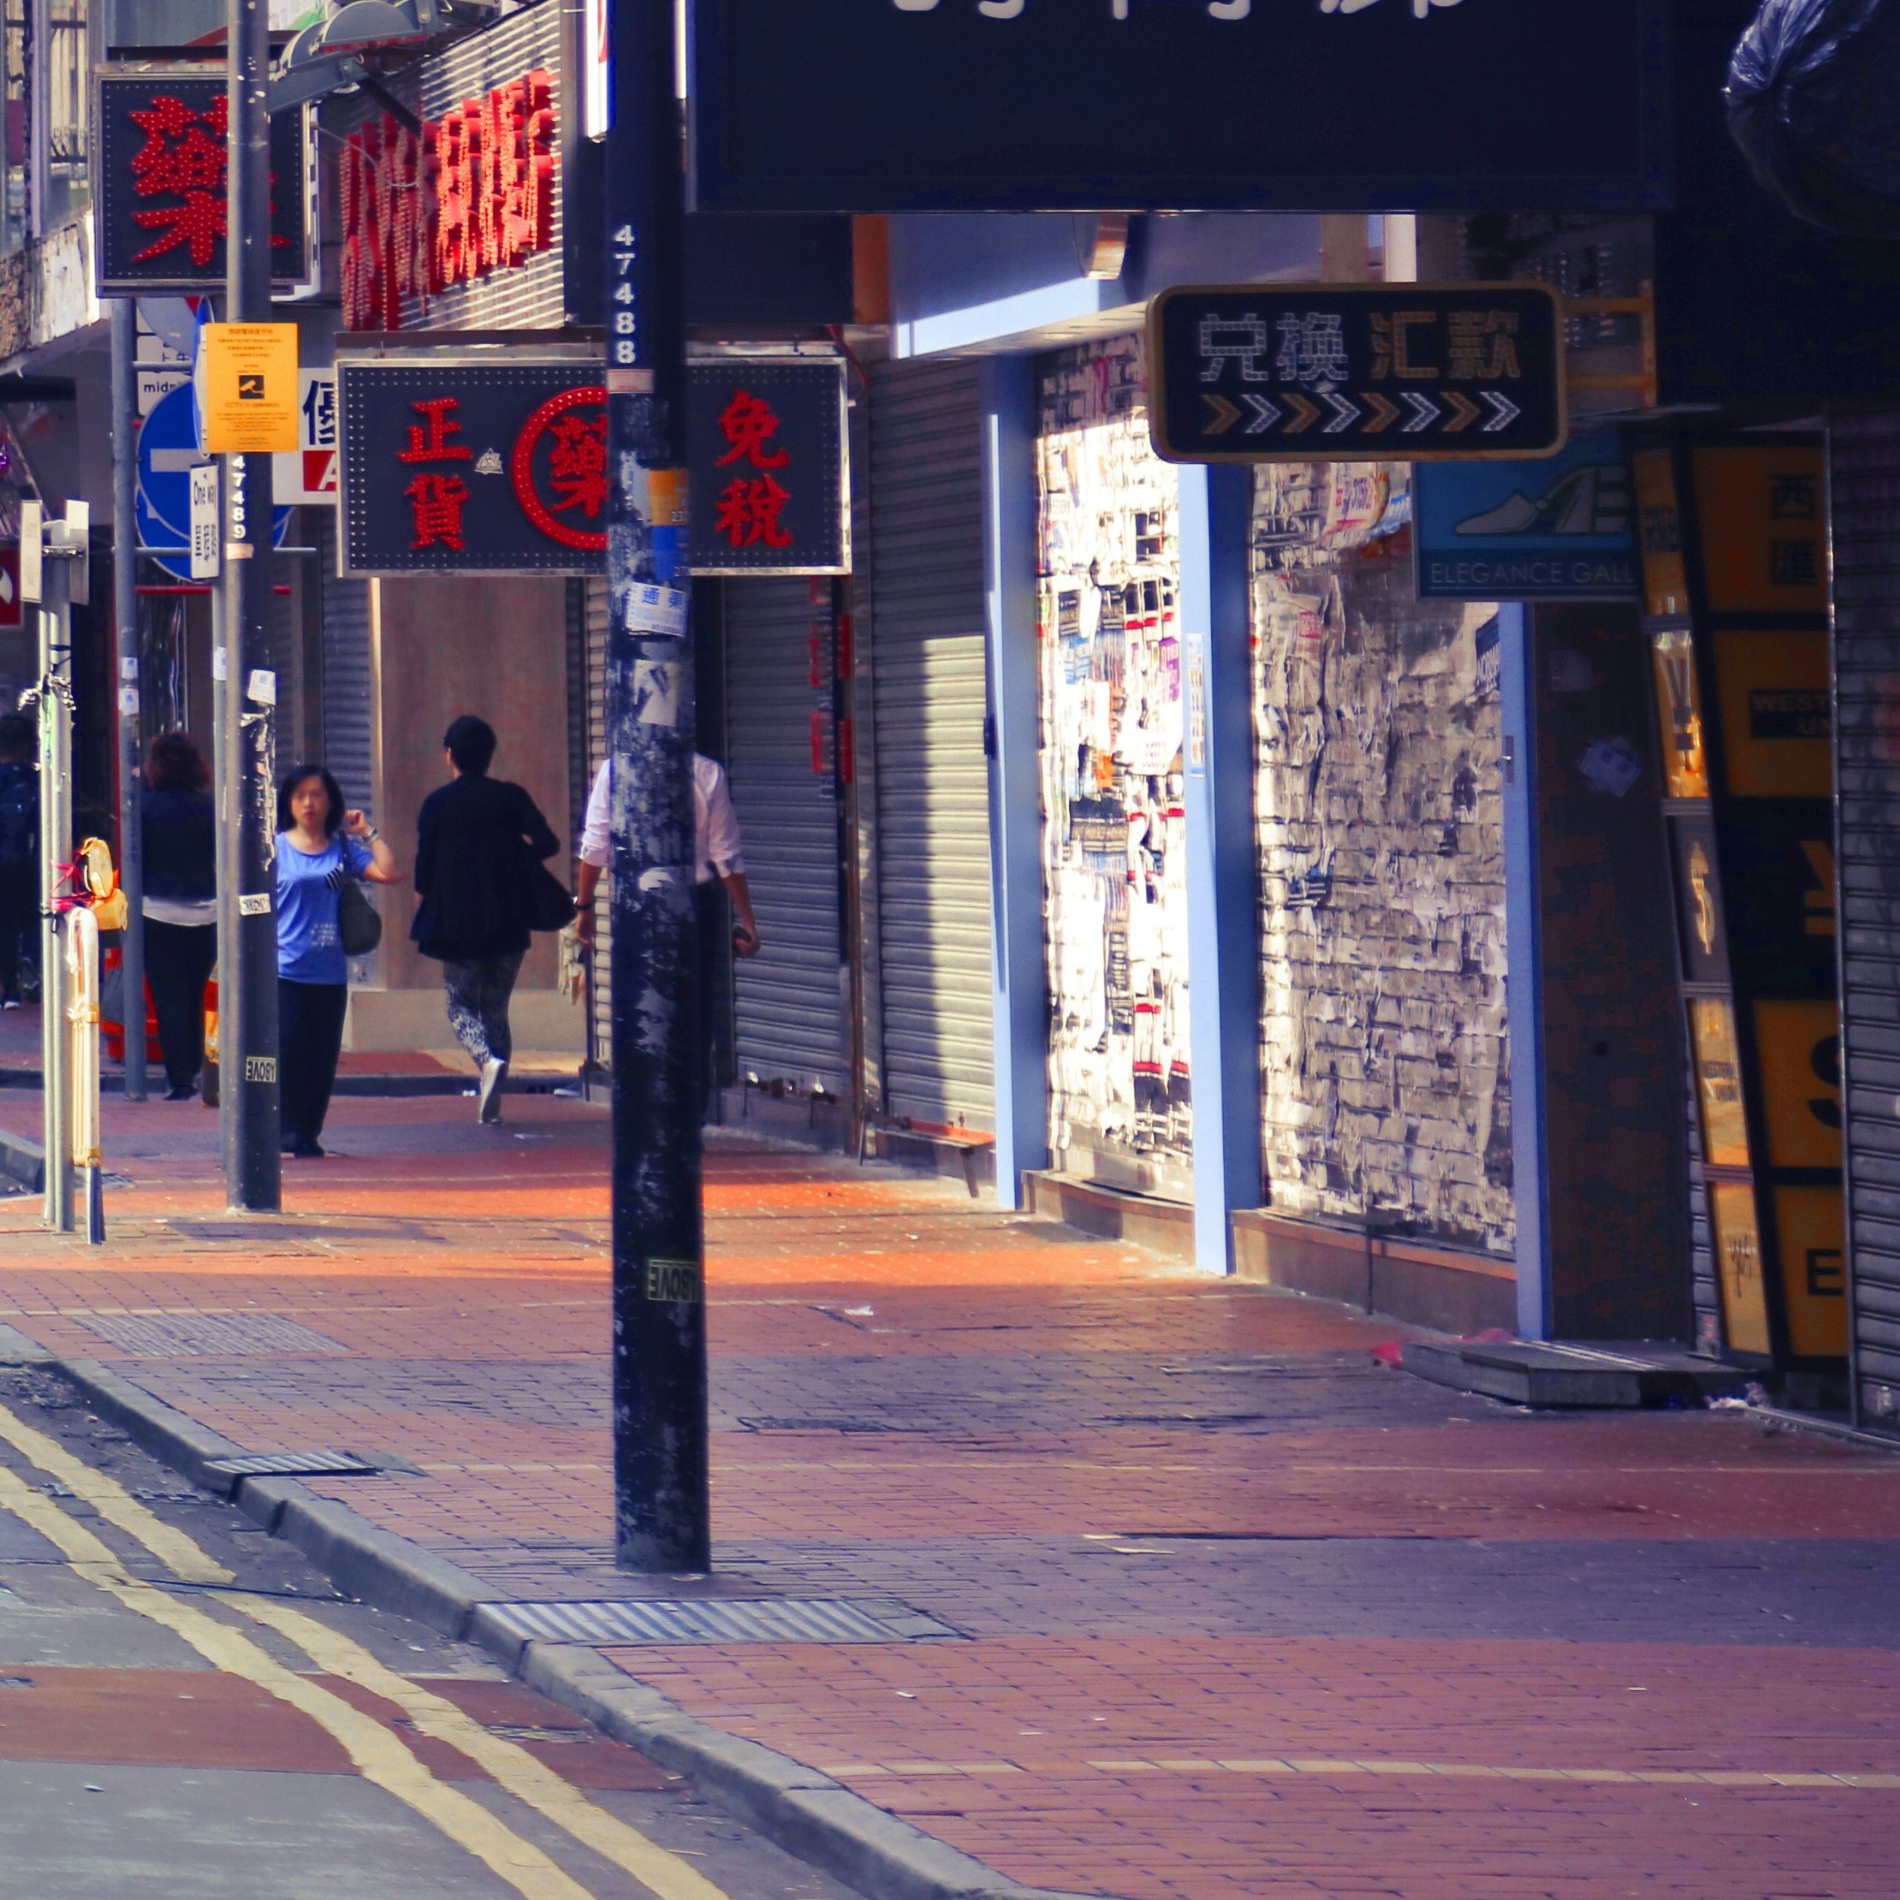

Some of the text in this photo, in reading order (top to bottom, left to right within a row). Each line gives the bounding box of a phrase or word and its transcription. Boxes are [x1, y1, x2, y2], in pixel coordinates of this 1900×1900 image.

[613, 224, 637, 365] 47488
[231, 455, 246, 540] 47489
[398, 396, 474, 554] 正貨
[1431, 561, 1637, 585] ELEGANCE GALL
